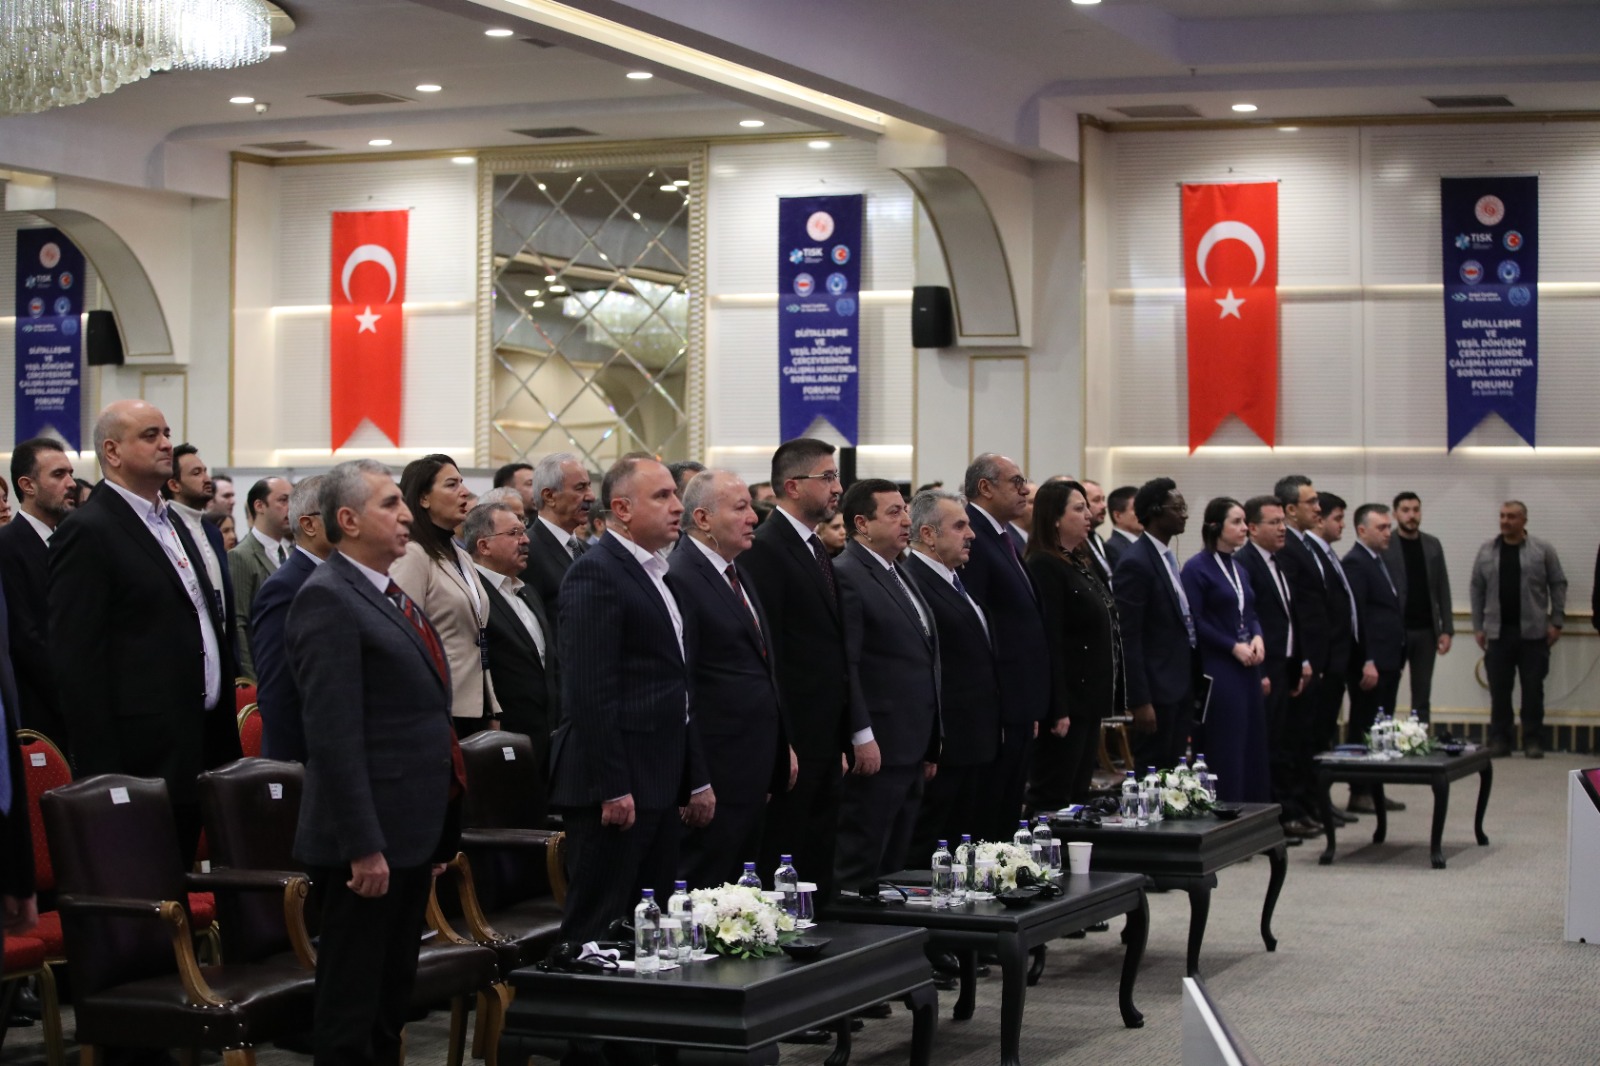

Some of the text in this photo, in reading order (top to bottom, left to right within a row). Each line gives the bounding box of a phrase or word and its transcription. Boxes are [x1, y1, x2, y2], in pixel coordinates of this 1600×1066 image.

[1485, 329, 1497, 338] VE
[1456, 368, 1522, 377] SOSYAL ADALET
[1471, 380, 1514, 389] FORUMU
